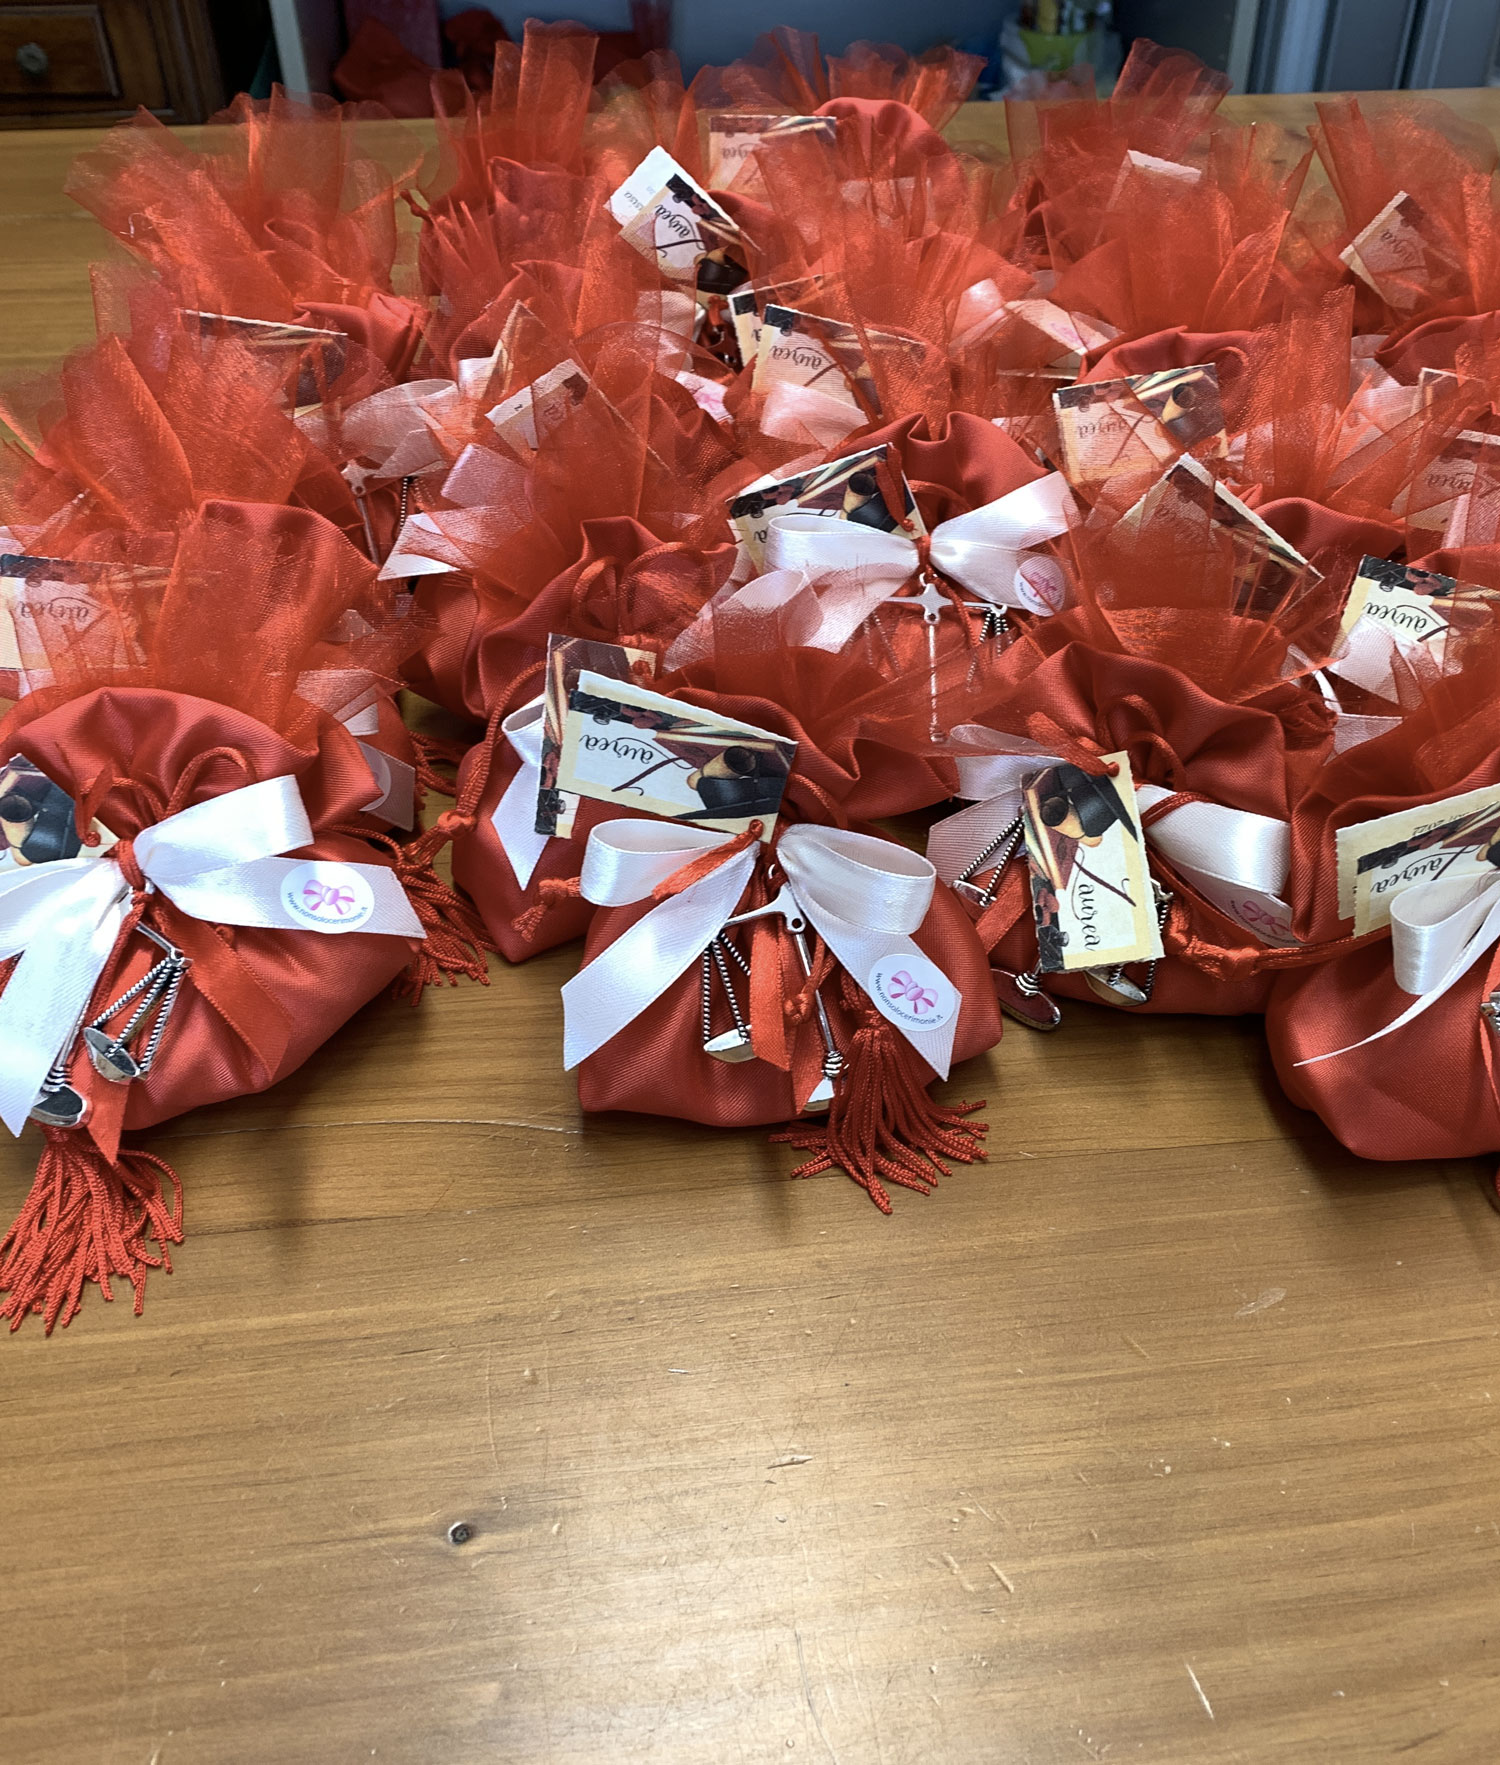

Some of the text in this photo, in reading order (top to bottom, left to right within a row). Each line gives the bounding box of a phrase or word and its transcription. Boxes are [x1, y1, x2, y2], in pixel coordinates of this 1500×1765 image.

[652, 204, 706, 258] Laurea
[579, 734, 693, 796] Laurea
[1370, 845, 1481, 893] Laurea
[1071, 846, 1137, 952] Laurea
[875, 972, 943, 1024] www.nonsolocerimonie.it
